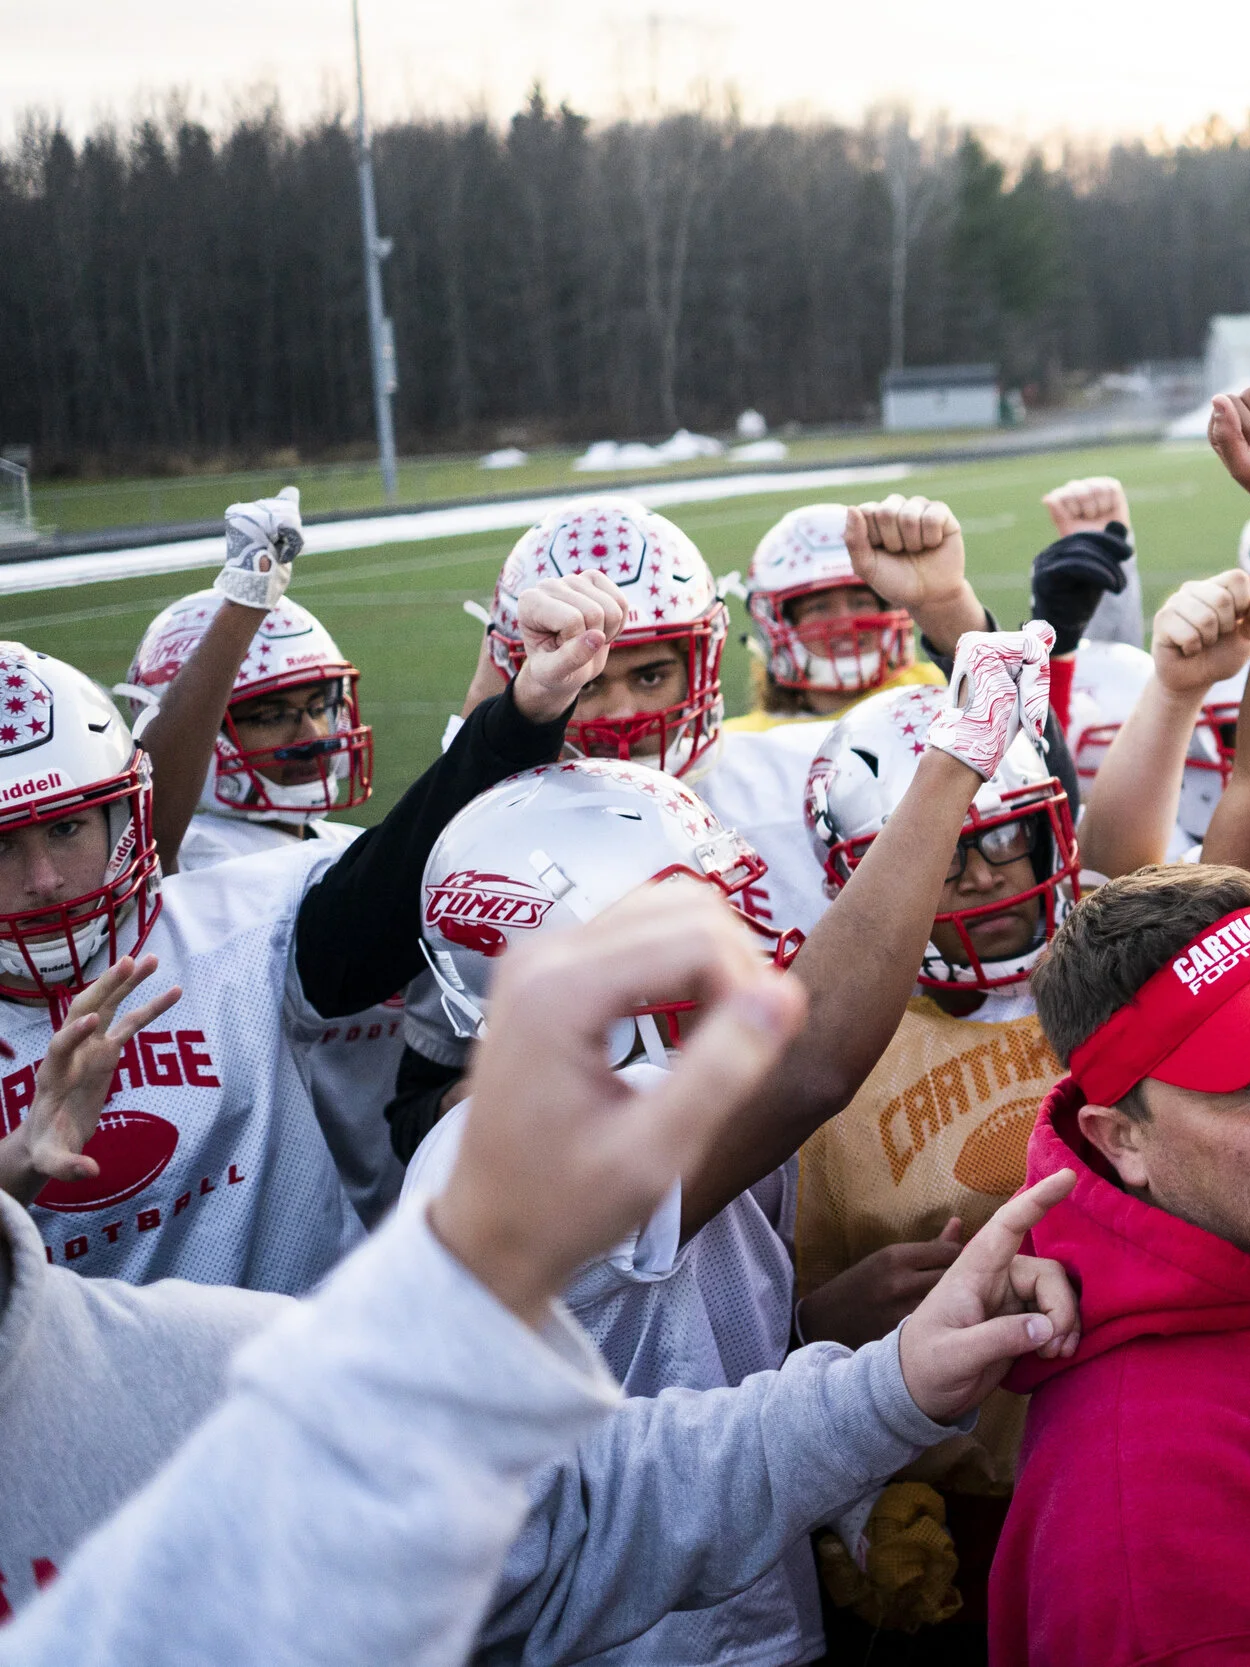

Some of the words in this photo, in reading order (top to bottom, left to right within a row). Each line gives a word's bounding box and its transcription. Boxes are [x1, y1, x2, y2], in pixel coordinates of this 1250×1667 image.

[107, 819, 137, 874] Ridde
[426, 890, 543, 924] COMETS
[39, 959, 73, 974] Ridde
[321, 1021, 400, 1043] FOOT
[0, 1030, 221, 1138] RAGE
[879, 1029, 1066, 1187] CARTHA
[46, 1164, 245, 1264] OTBALL
